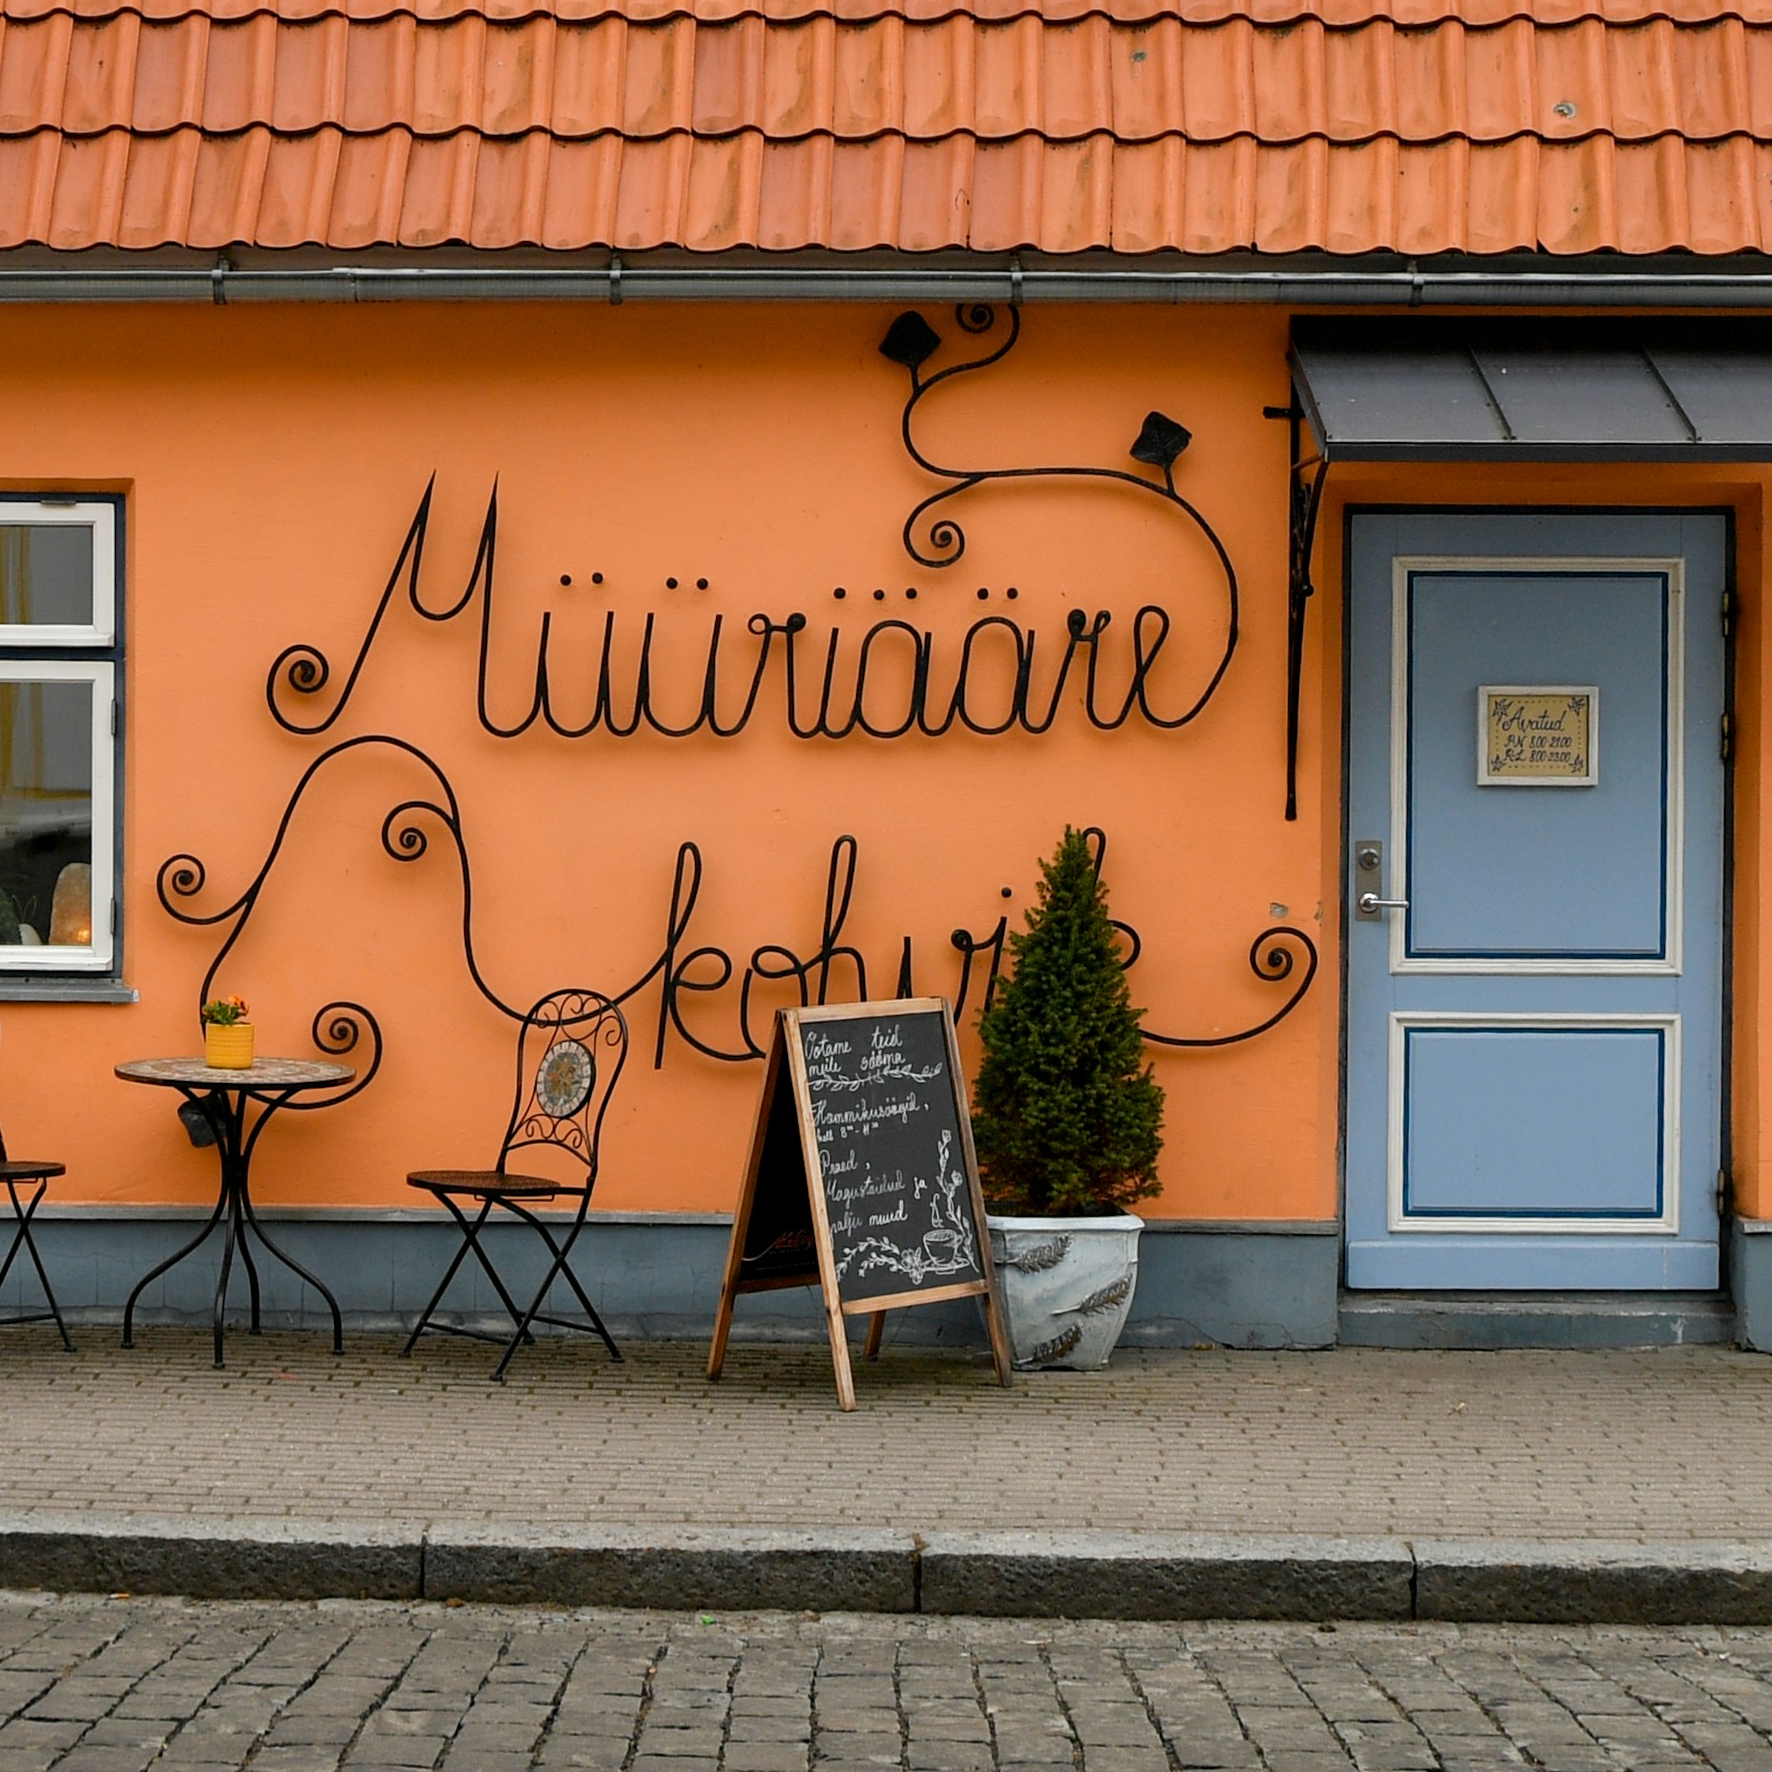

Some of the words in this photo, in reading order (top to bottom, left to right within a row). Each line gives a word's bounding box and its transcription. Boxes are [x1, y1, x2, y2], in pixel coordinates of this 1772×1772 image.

[1502, 706, 1567, 733] Avatud
[871, 1024, 903, 1049] teid
[913, 1176, 928, 1200] ja
[868, 1199, 908, 1227] muud
